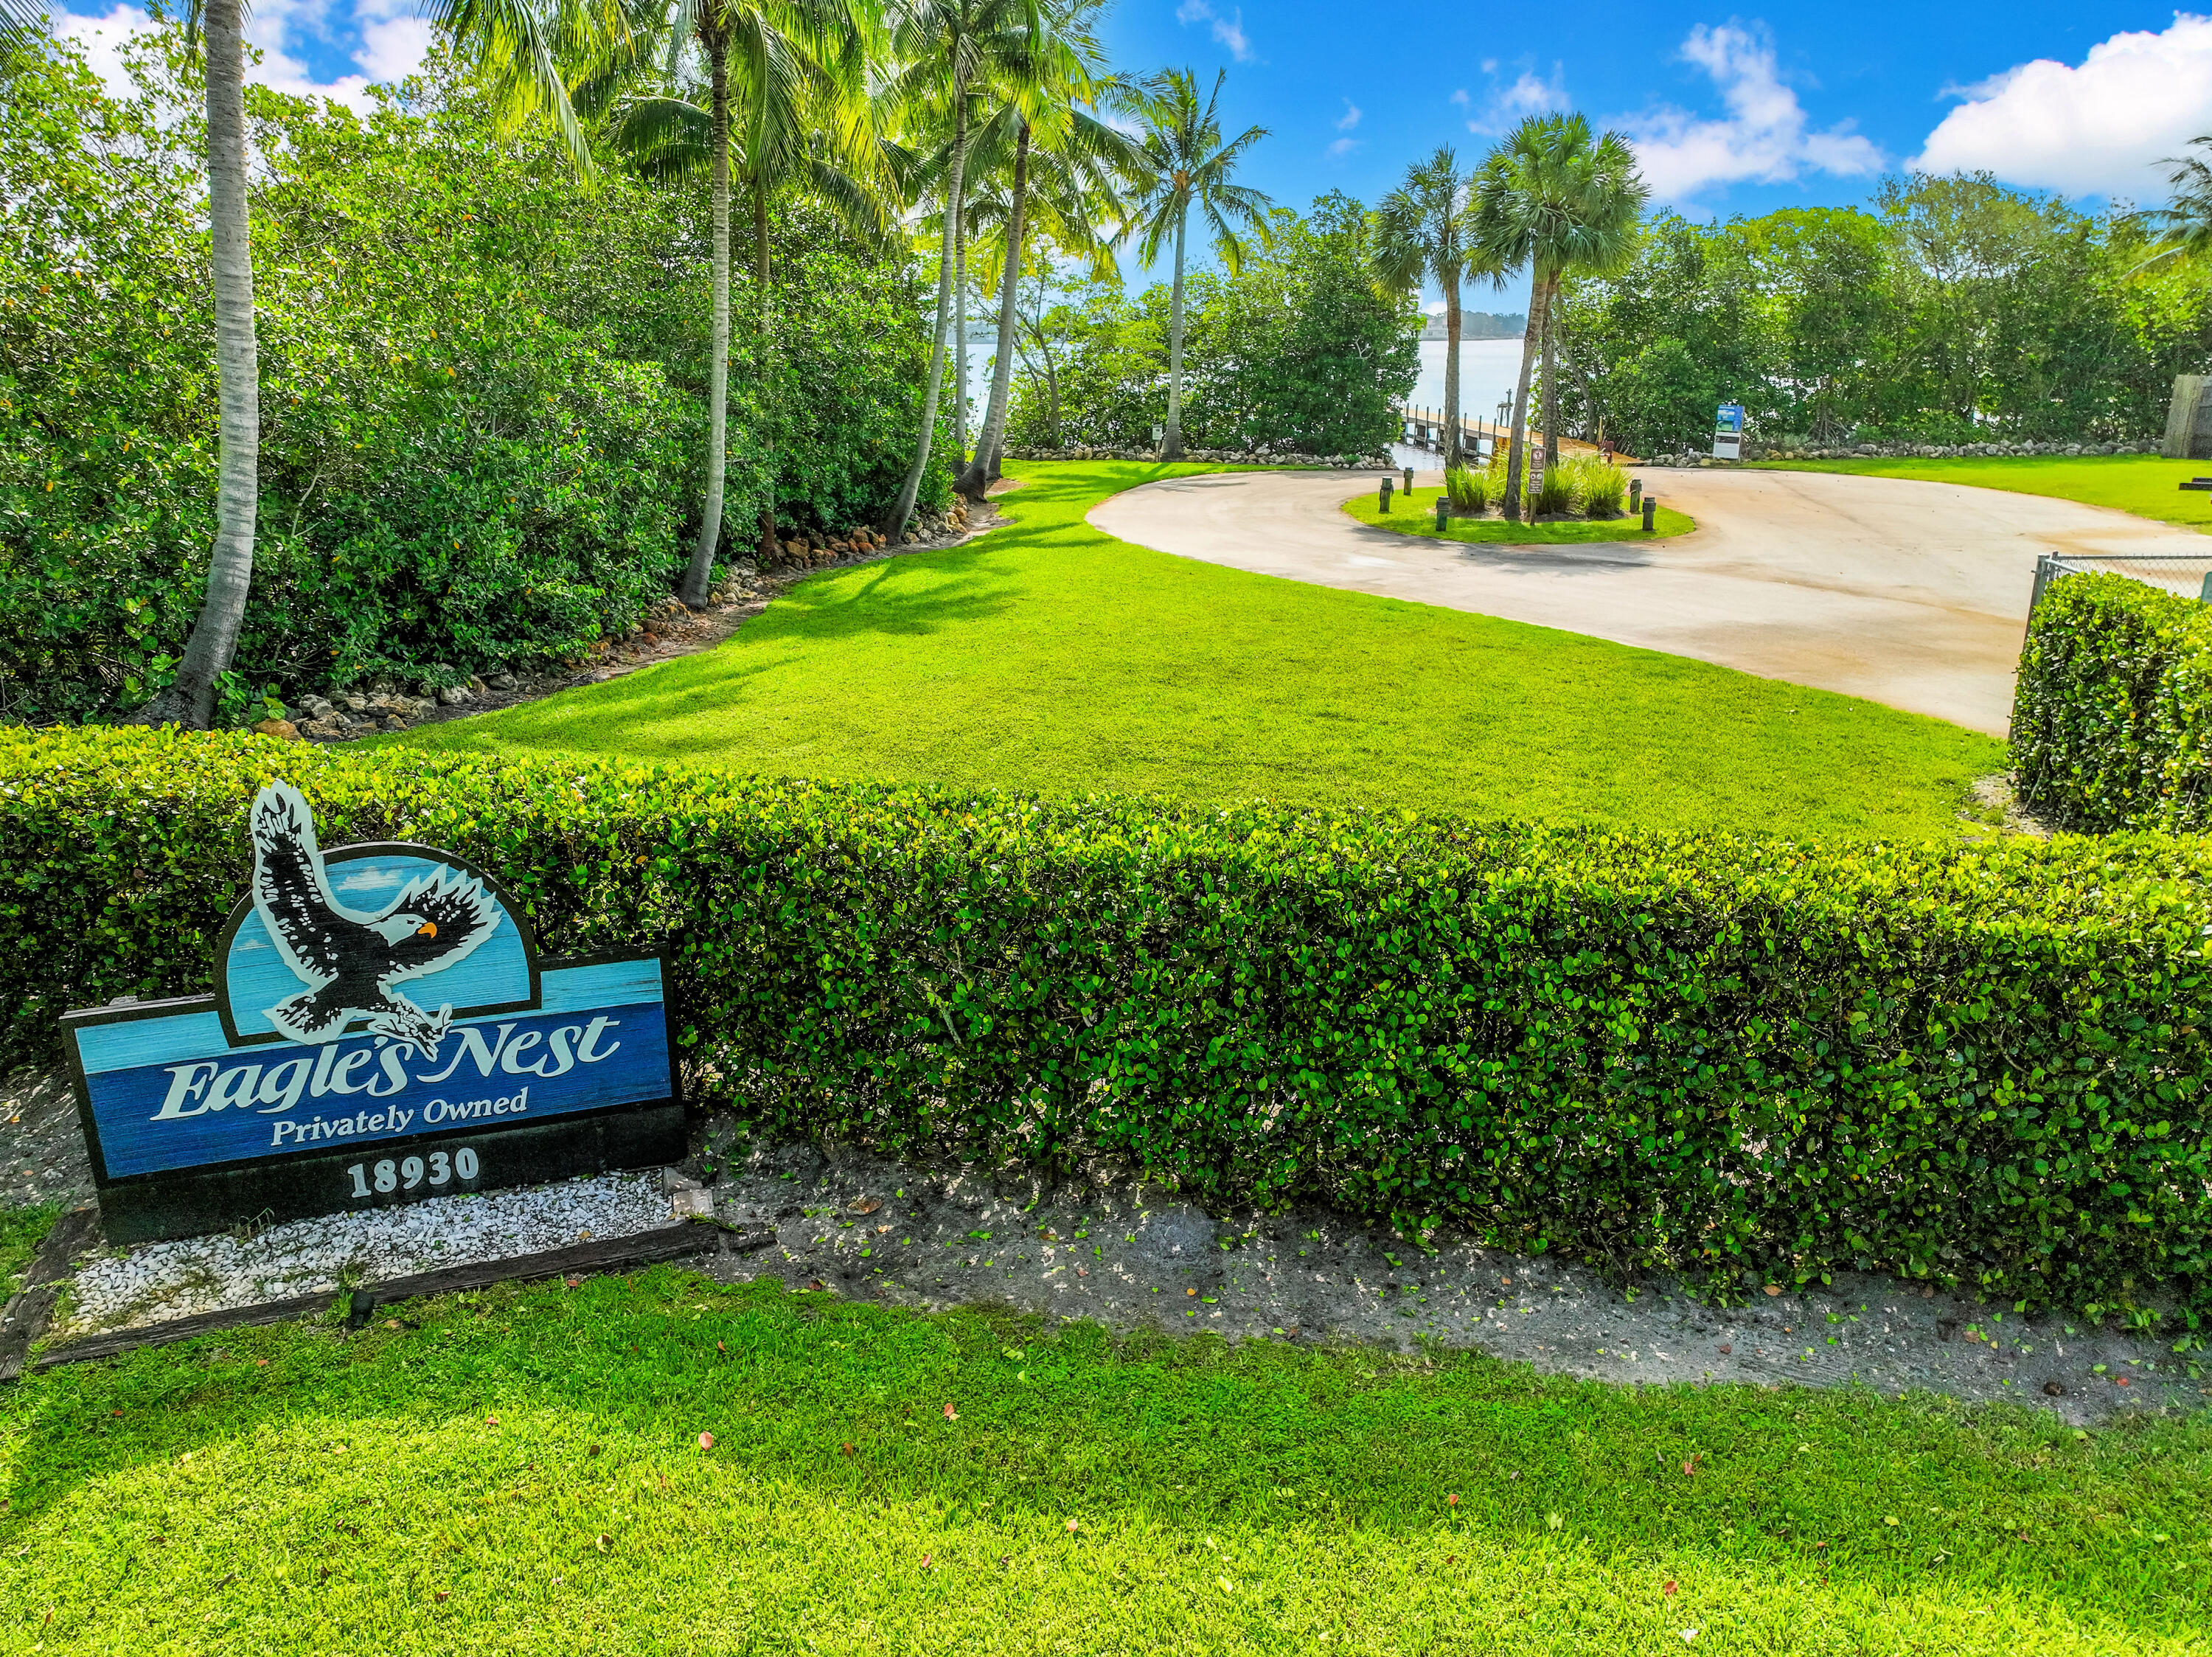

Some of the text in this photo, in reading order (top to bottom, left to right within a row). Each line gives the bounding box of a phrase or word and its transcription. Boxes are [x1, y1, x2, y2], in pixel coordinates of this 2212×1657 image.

[150, 1016, 621, 1121] Eagle's Nest
[270, 1086, 528, 1147] Privately Owned
[347, 1147, 480, 1198] 18930
